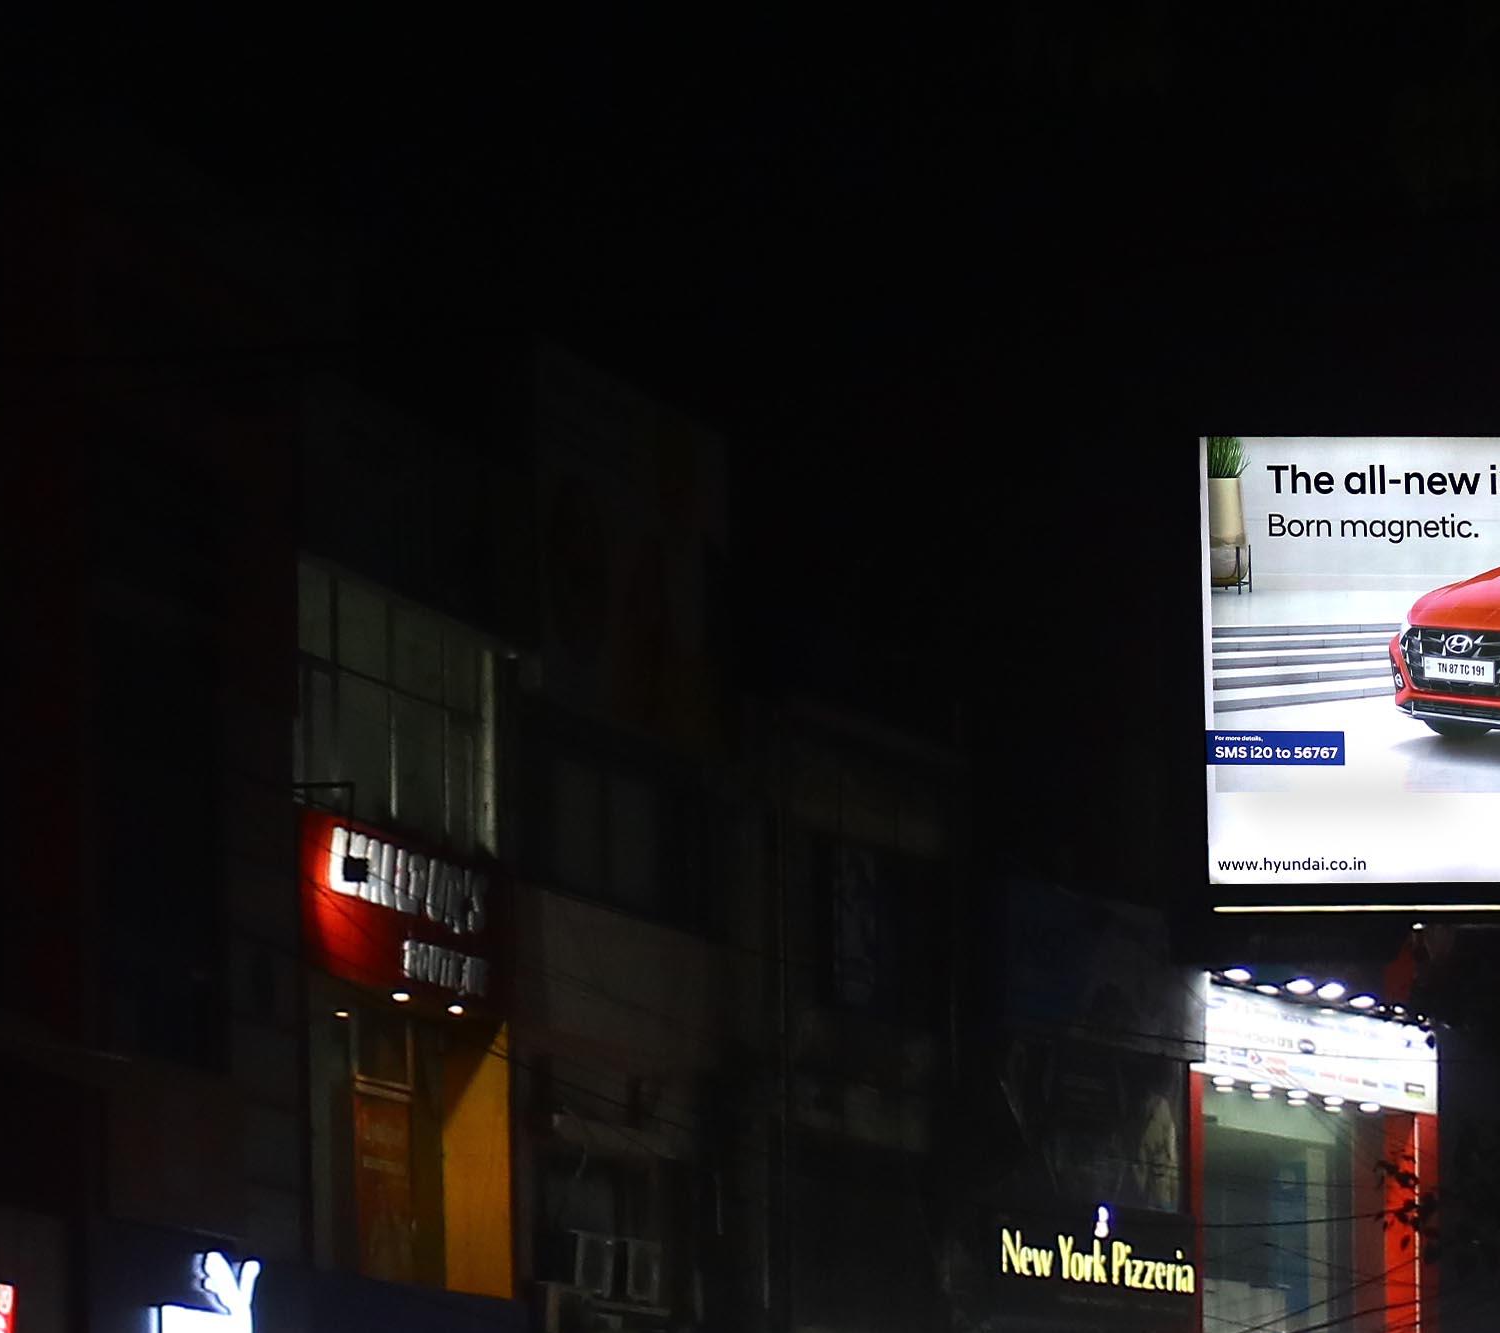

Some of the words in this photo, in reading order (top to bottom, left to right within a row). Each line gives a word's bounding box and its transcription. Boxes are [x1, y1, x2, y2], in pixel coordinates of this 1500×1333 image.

[1267, 464, 1334, 495] The
[1344, 464, 1481, 496] all-new
[1268, 513, 1332, 538] Born
[1340, 512, 1479, 544] magnetic.
[1438, 662, 1448, 673] TN
[1449, 664, 1458, 674] 87
[1460, 664, 1470, 675] TC
[1472, 665, 1485, 676] 191
[1241, 735, 1264, 743] details,
[1215, 746, 1248, 760] SMS
[1250, 746, 1273, 760] i20
[1275, 747, 1291, 759] to
[1293, 746, 1338, 760] 56767
[1217, 855, 1368, 874] www.hyundai.co.in
[1002, 1228, 1053, 1277] New
[1058, 1234, 1108, 1284] York
[1112, 1240, 1196, 1294] Pizzeria
